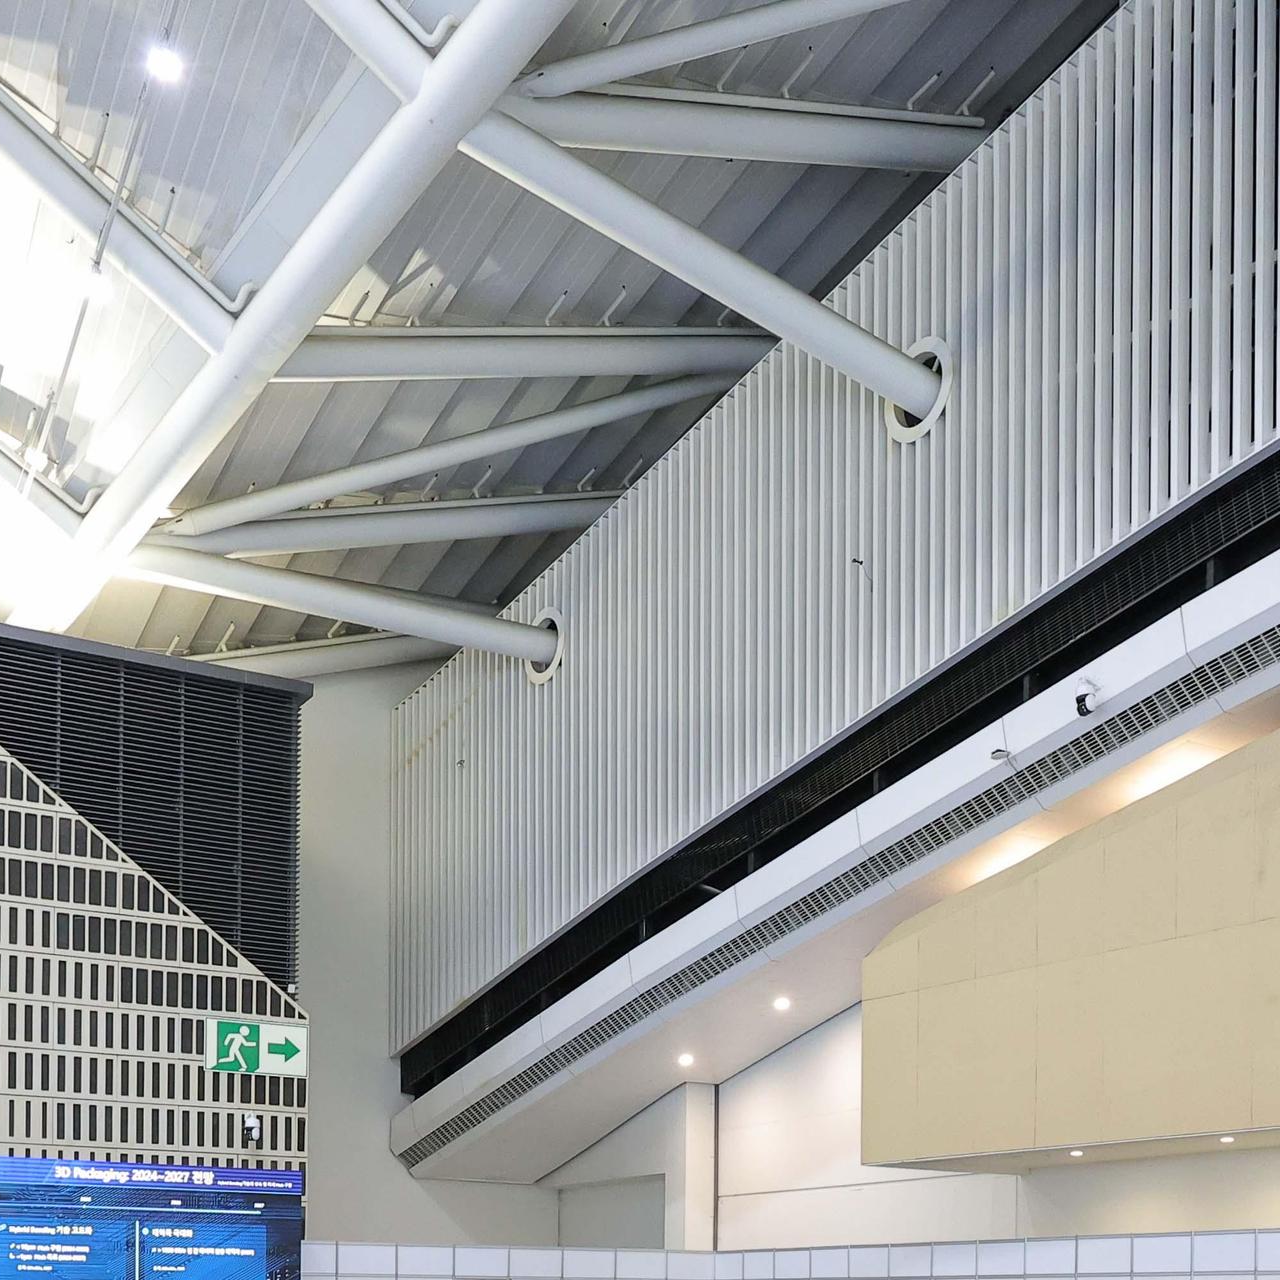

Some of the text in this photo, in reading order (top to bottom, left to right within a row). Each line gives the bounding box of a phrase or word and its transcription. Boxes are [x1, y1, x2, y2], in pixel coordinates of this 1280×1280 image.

[55, 1166, 71, 1178] 3D
[74, 1166, 130, 1183] Packaging:
[131, 1169, 190, 1183] 2024~2027
